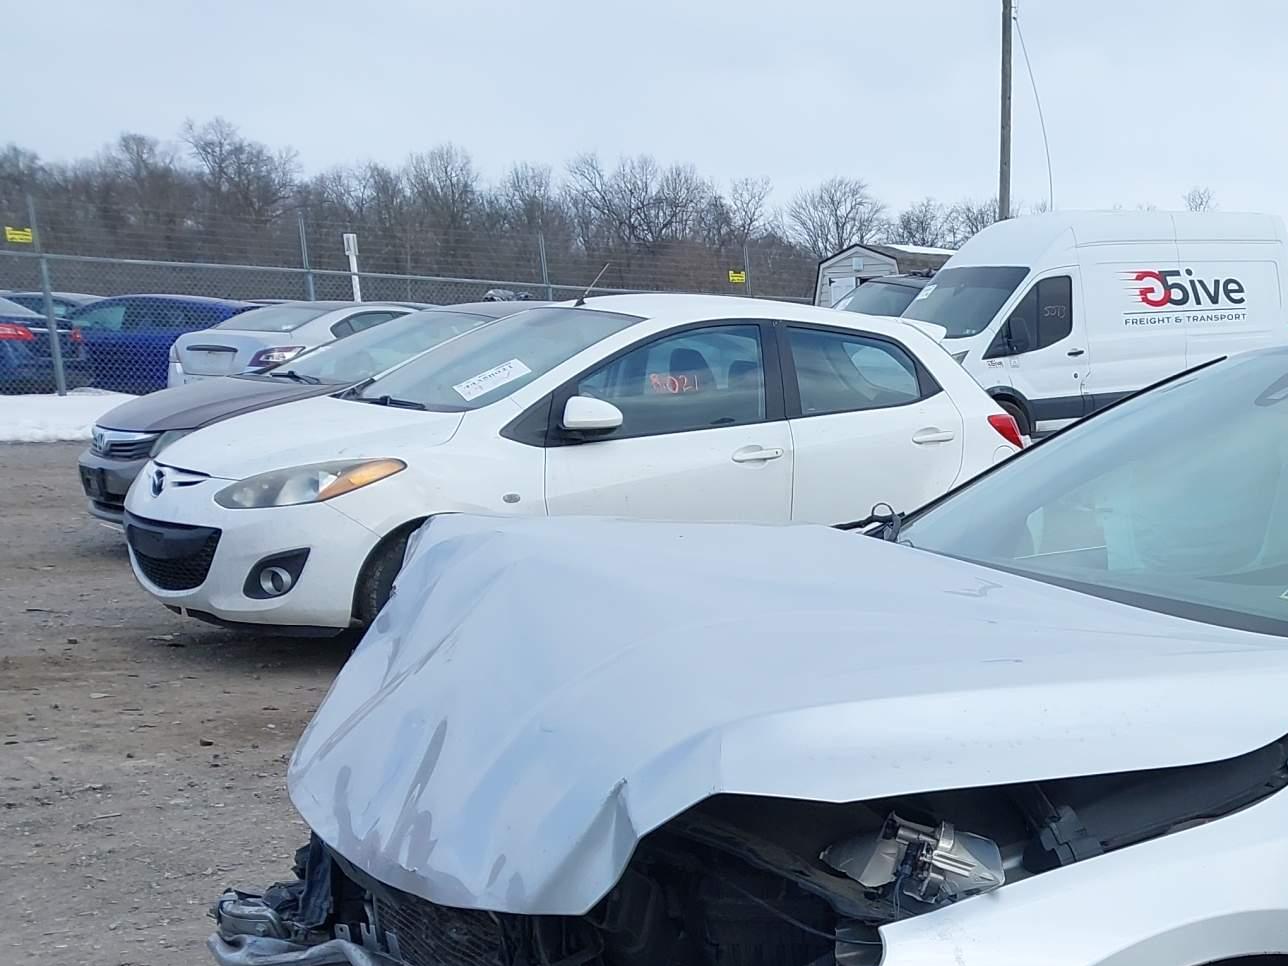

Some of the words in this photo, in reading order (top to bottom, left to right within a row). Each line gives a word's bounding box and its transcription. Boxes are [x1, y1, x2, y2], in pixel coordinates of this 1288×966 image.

[1124, 316, 1172, 326] FREIGHT
[1174, 316, 1183, 324] &
[1186, 313, 1248, 323] TRANSPORT
